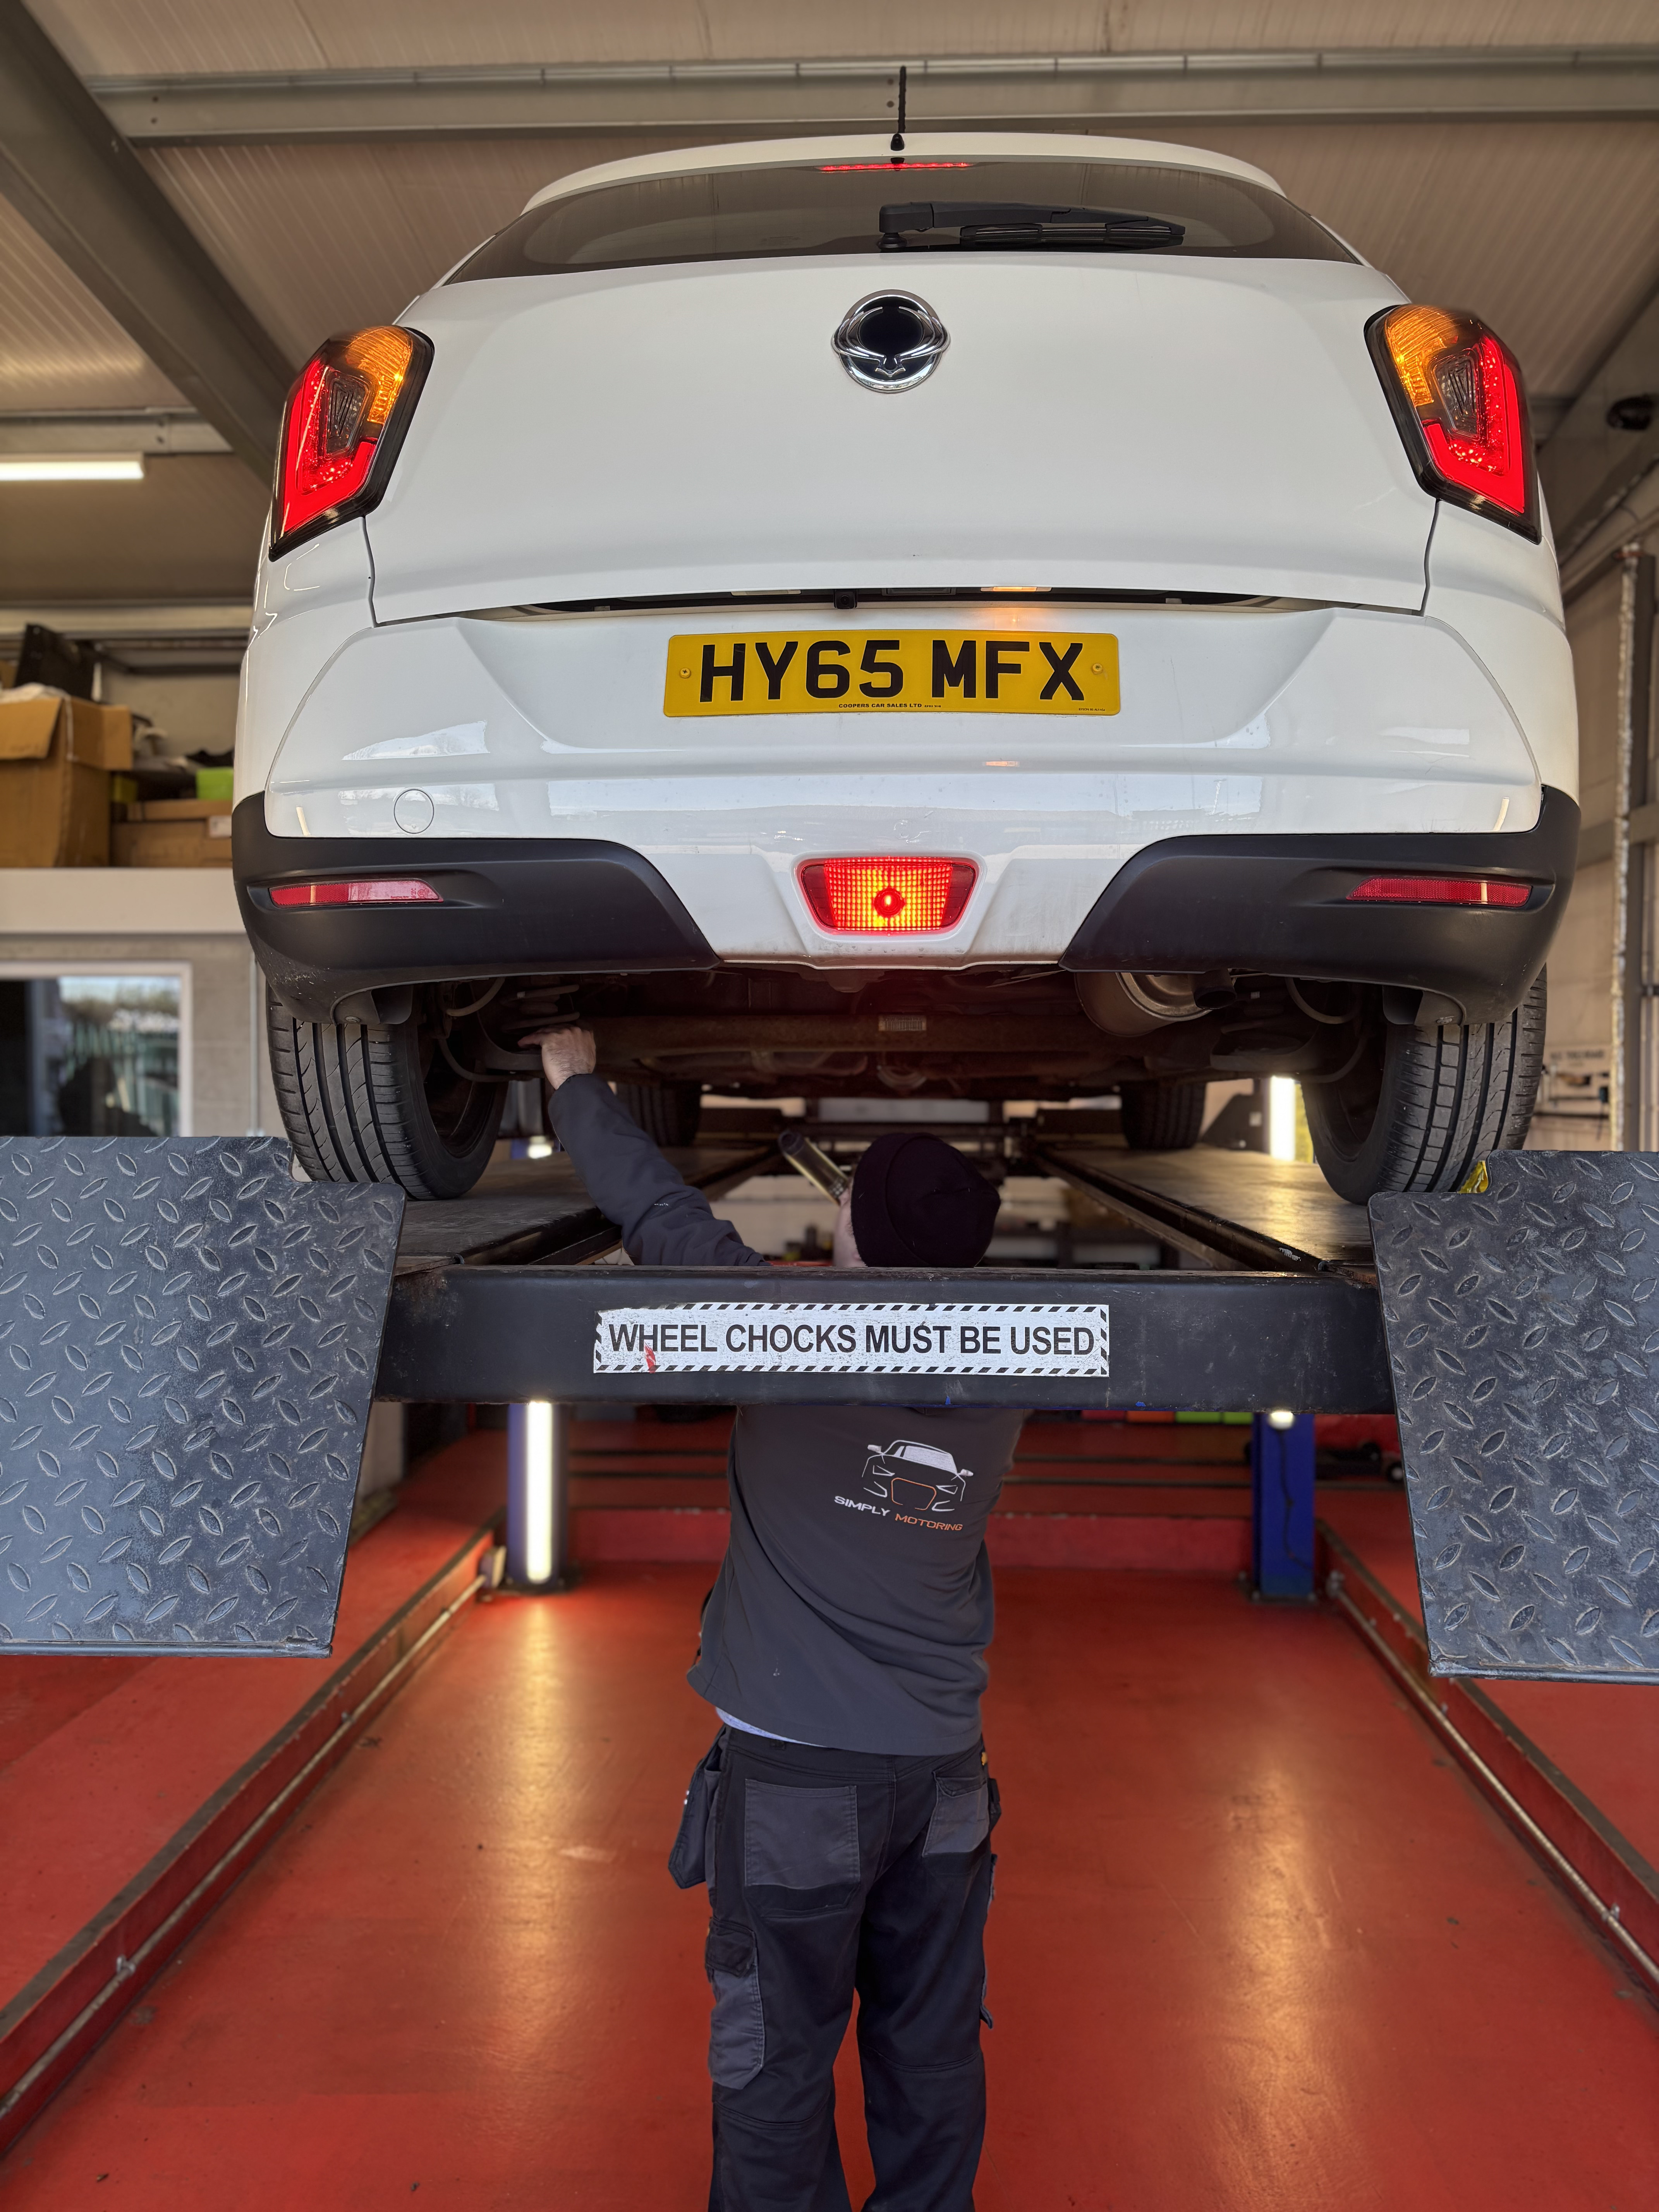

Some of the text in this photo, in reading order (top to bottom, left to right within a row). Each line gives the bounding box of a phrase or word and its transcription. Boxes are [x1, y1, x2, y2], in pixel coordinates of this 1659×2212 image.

[700, 640, 1084, 702] HY65 MFX
[608, 1324, 1094, 1355] WHEEL CHOCKS MUST BE USED
[834, 1495, 963, 1531] SIMPLY MOTORING
